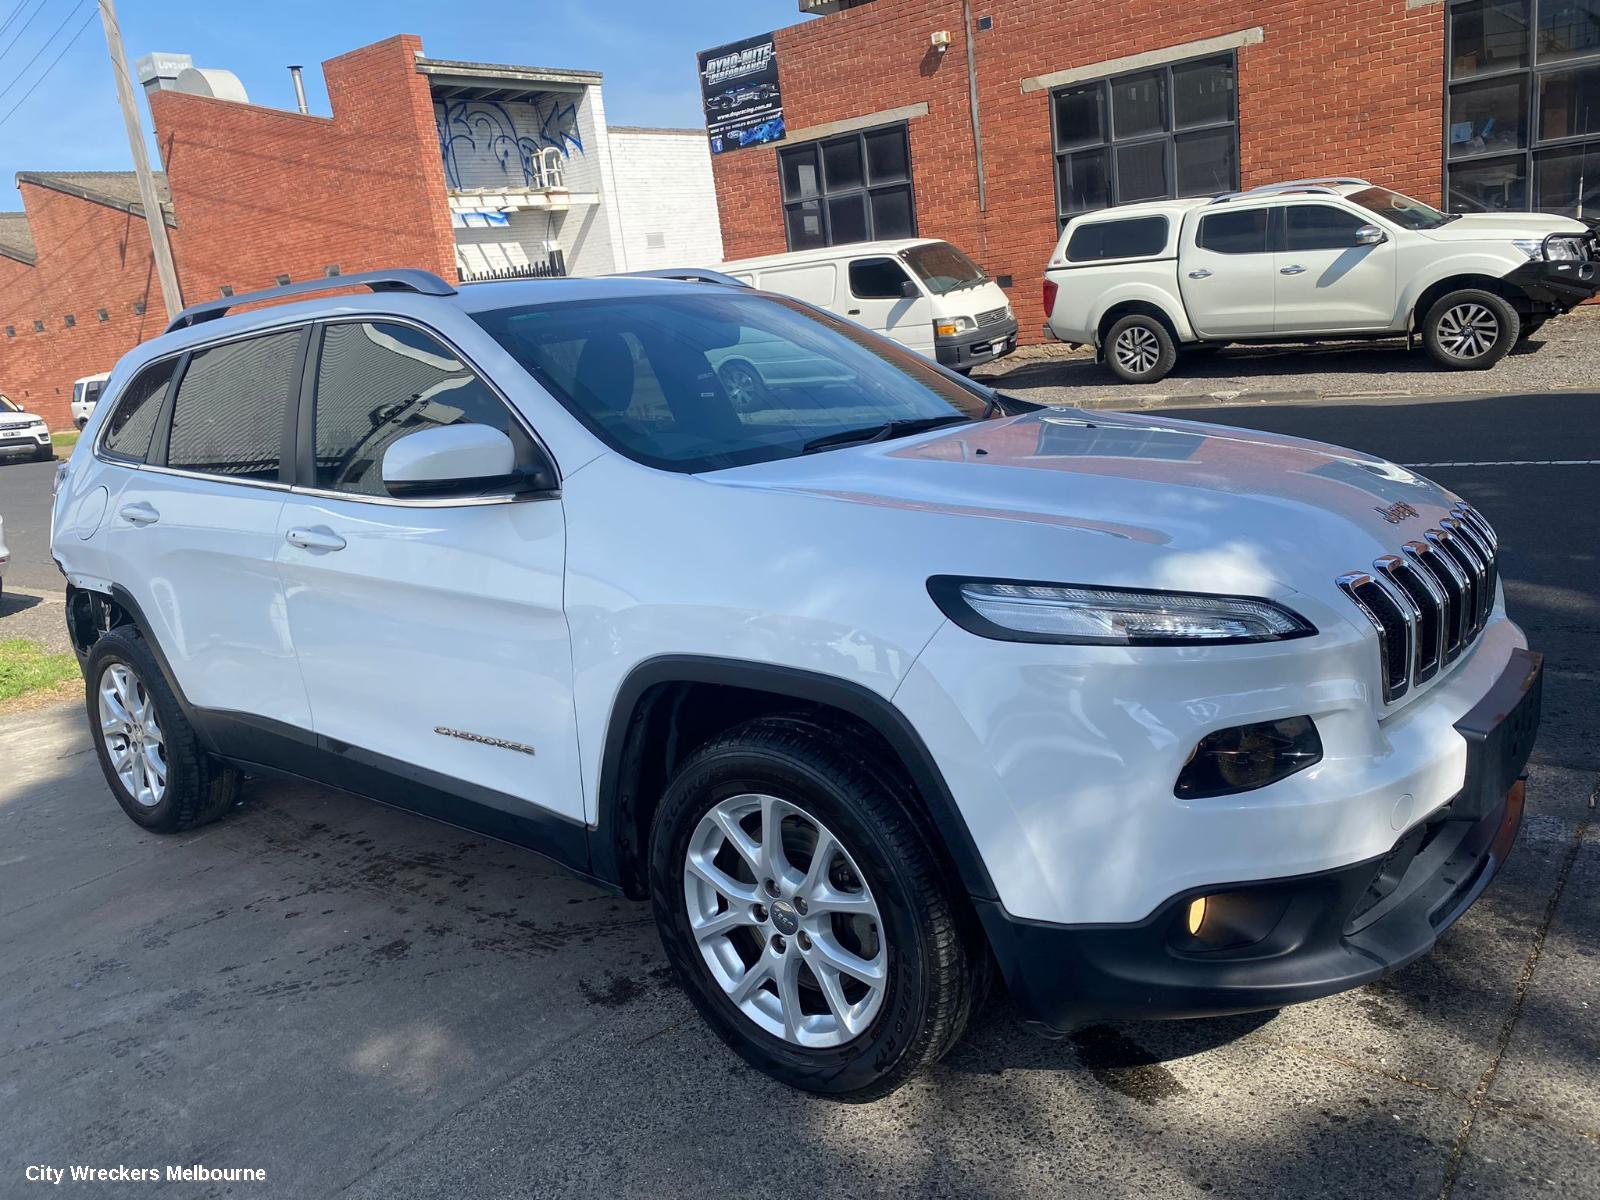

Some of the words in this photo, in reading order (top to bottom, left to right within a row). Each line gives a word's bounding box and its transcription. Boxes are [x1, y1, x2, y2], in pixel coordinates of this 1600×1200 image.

[708, 45, 771, 75] DYNO-MITE
[709, 60, 767, 83] PERFORMANCE
[1374, 501, 1419, 524] Jeep
[433, 726, 536, 756] CHEROKEE
